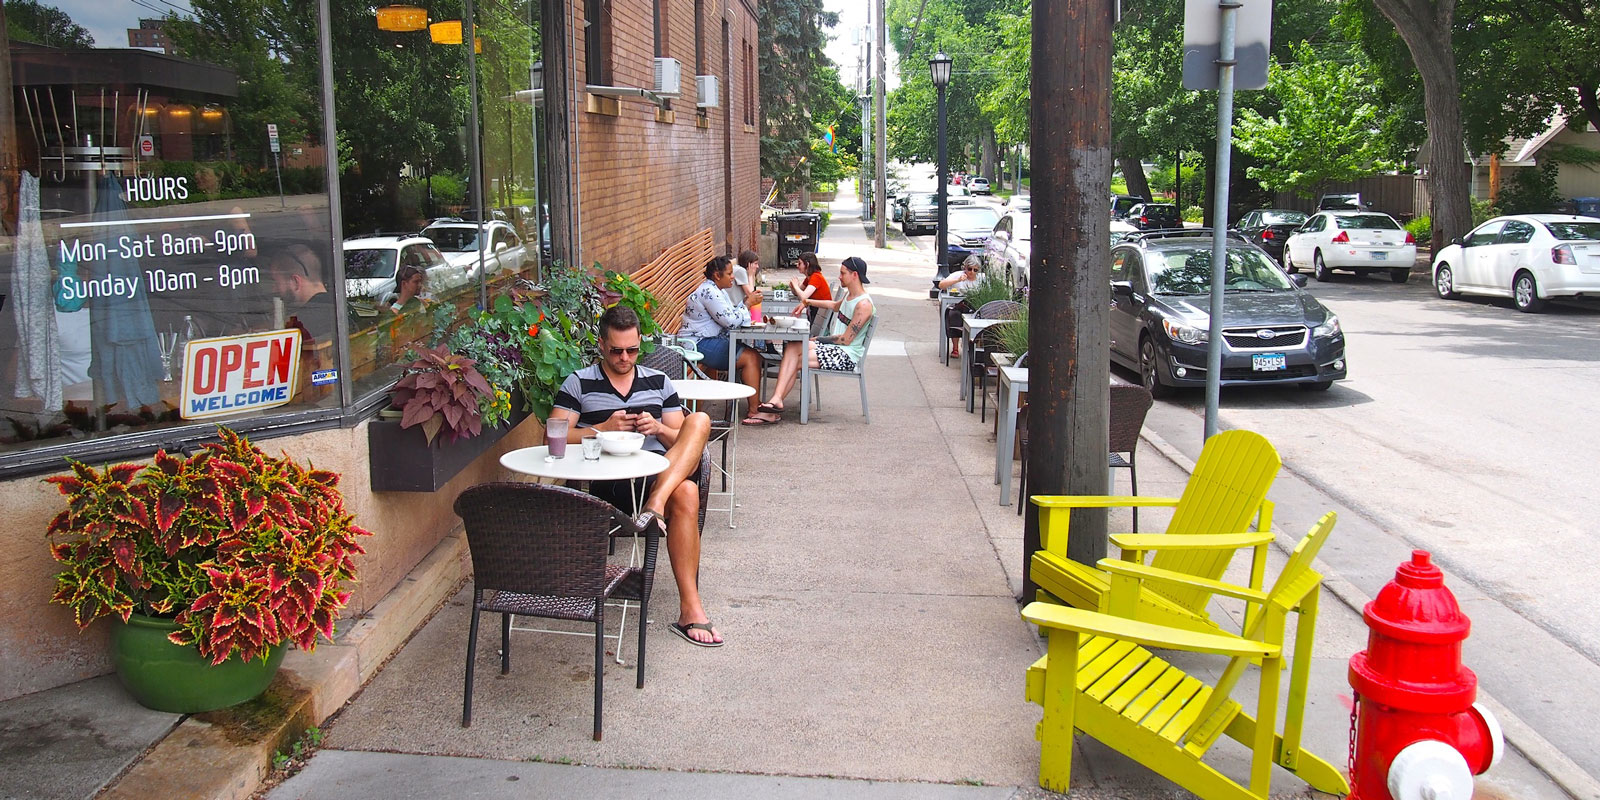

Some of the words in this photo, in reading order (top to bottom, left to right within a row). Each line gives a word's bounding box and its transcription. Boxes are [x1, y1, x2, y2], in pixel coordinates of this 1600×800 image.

[126, 177, 188, 201] HOURS
[60, 234, 156, 263] Mon-Sat
[161, 230, 256, 256] 8am-9pm
[62, 274, 139, 299] Sunday
[146, 269, 197, 293] 10am
[219, 264, 260, 289] 8pm
[193, 337, 293, 395] OPEN
[191, 386, 288, 413] WELCOME
